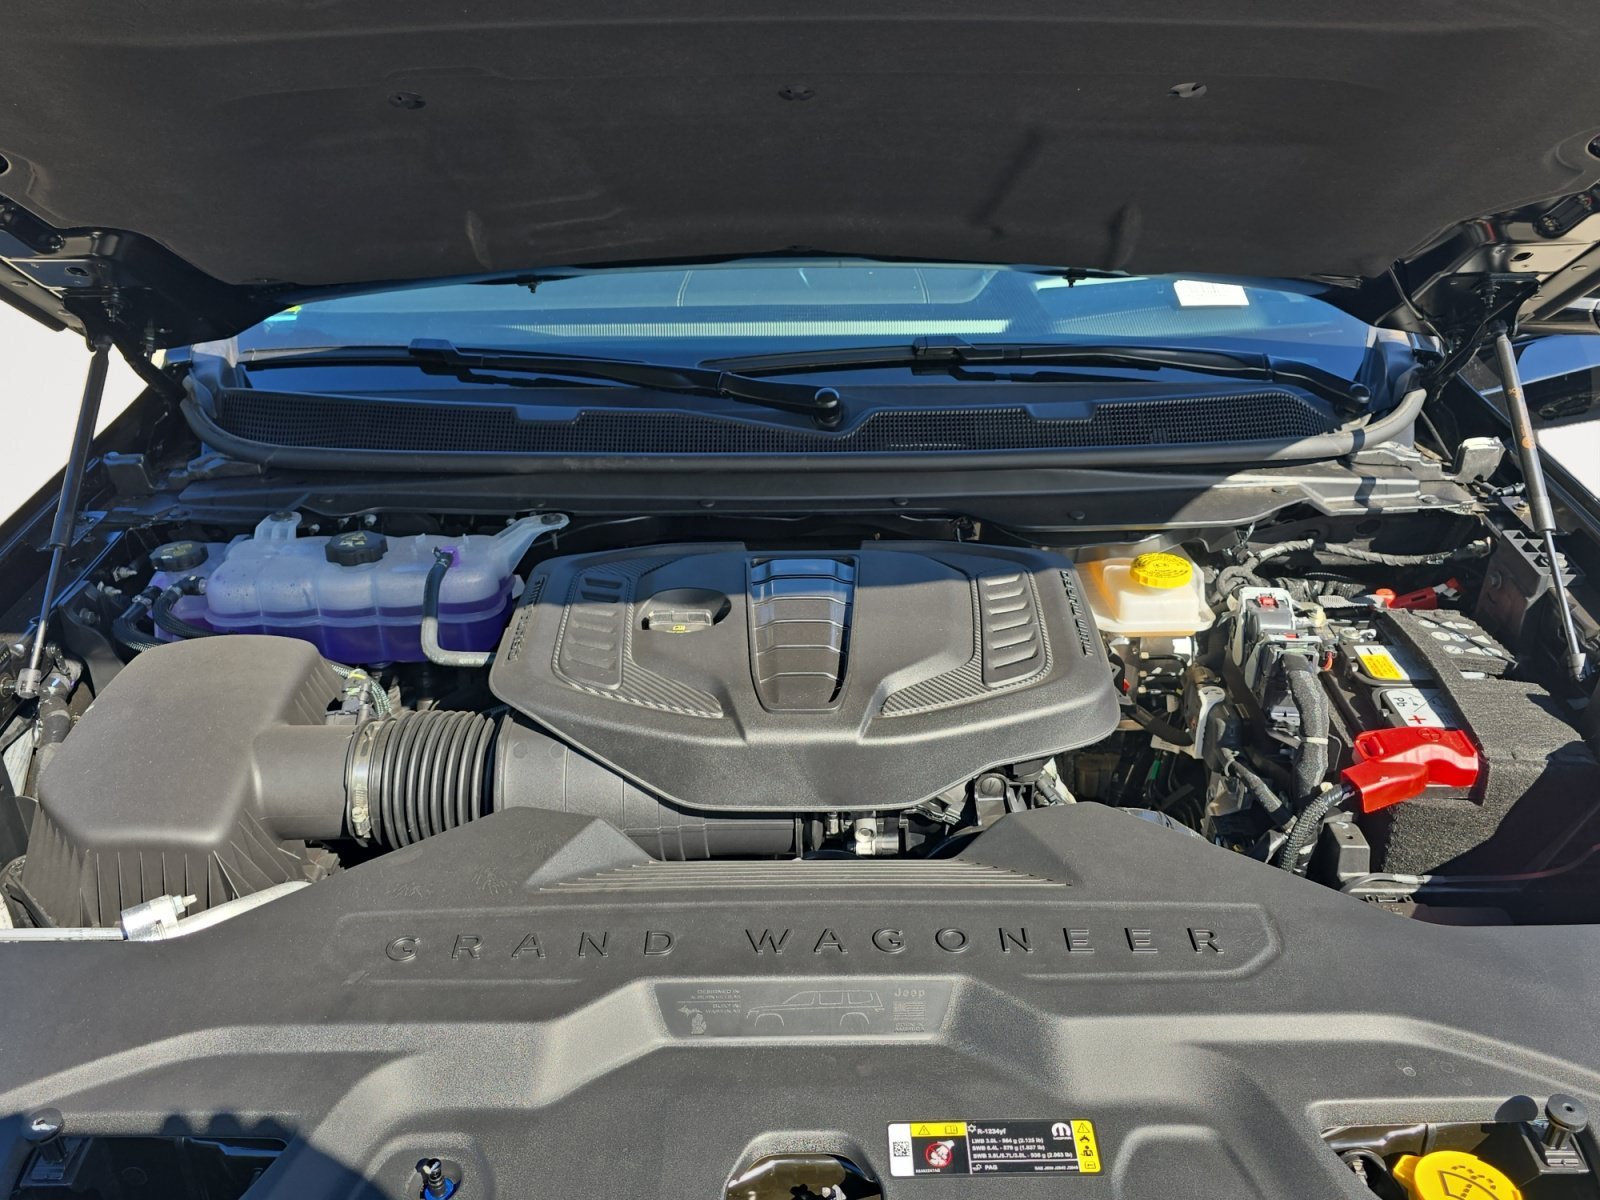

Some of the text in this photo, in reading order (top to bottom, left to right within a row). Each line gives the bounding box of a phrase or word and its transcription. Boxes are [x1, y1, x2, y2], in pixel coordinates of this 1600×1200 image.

[1393, 697, 1408, 708] Pb
[385, 927, 1225, 962] GRAND WAGONEER
[894, 987, 925, 999] Jeep
[977, 1127, 1006, 1136] R-1234yf
